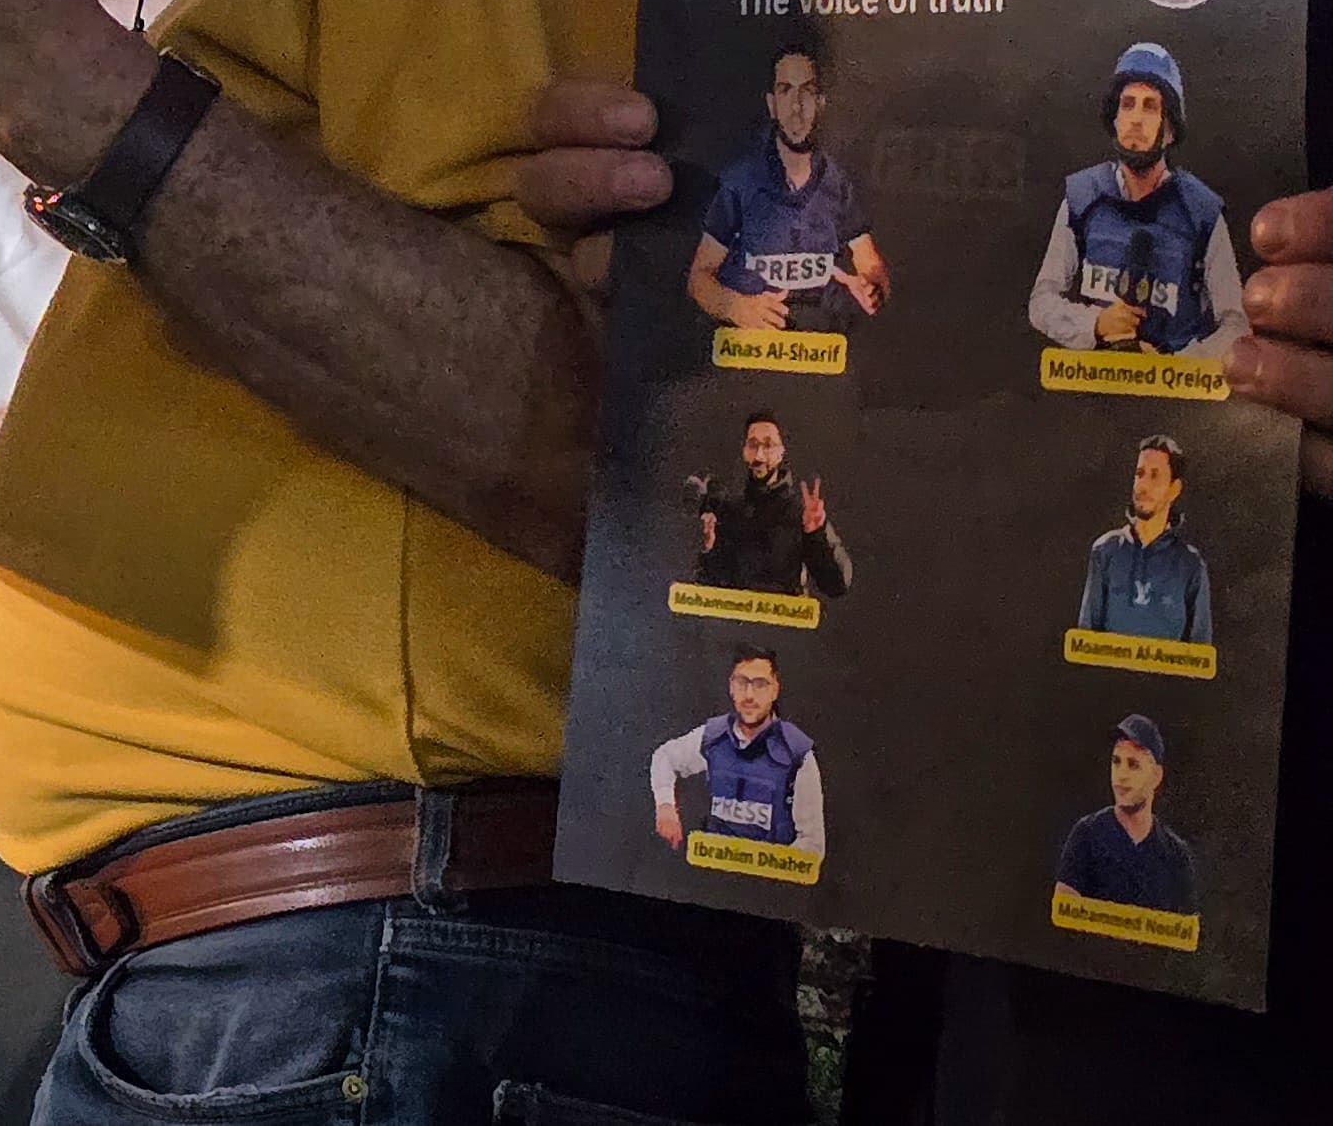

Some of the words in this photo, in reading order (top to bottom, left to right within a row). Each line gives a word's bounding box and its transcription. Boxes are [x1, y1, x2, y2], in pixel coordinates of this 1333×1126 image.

[755, 256, 827, 281] PRESS
[720, 338, 762, 357] Anas
[766, 342, 841, 363] Al-Sharif
[1048, 360, 1156, 385] Mohammed
[674, 591, 753, 612] Mohammed
[694, 841, 753, 865] Ibrahim
[758, 851, 813, 874] Dhaher
[1058, 902, 1142, 930] Mohammed
